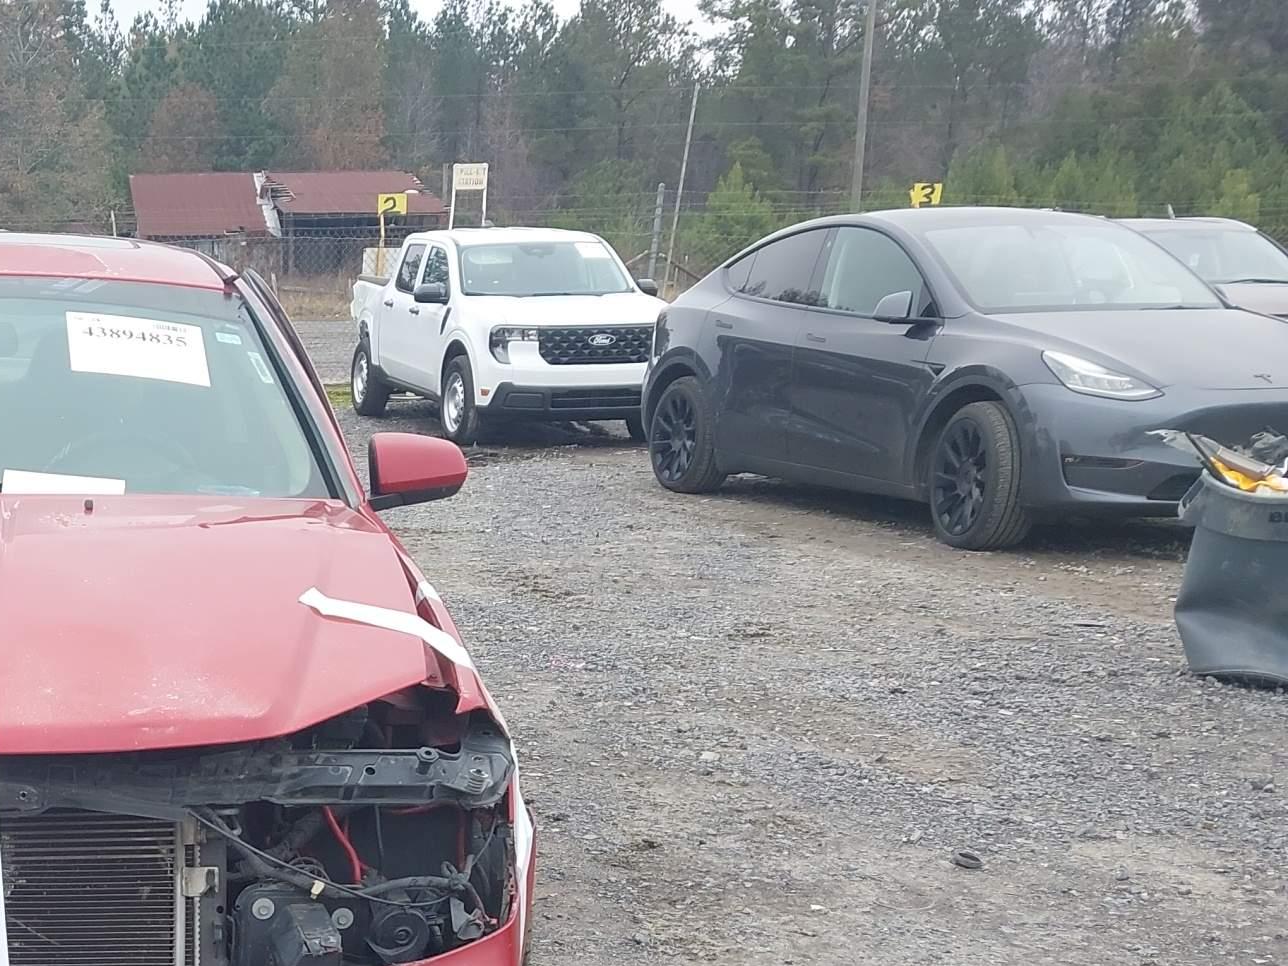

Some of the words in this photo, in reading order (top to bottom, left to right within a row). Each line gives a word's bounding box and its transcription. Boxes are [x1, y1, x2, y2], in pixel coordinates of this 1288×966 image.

[919, 183, 936, 204] 3
[379, 196, 401, 215] 2
[82, 326, 188, 347] 43894835
